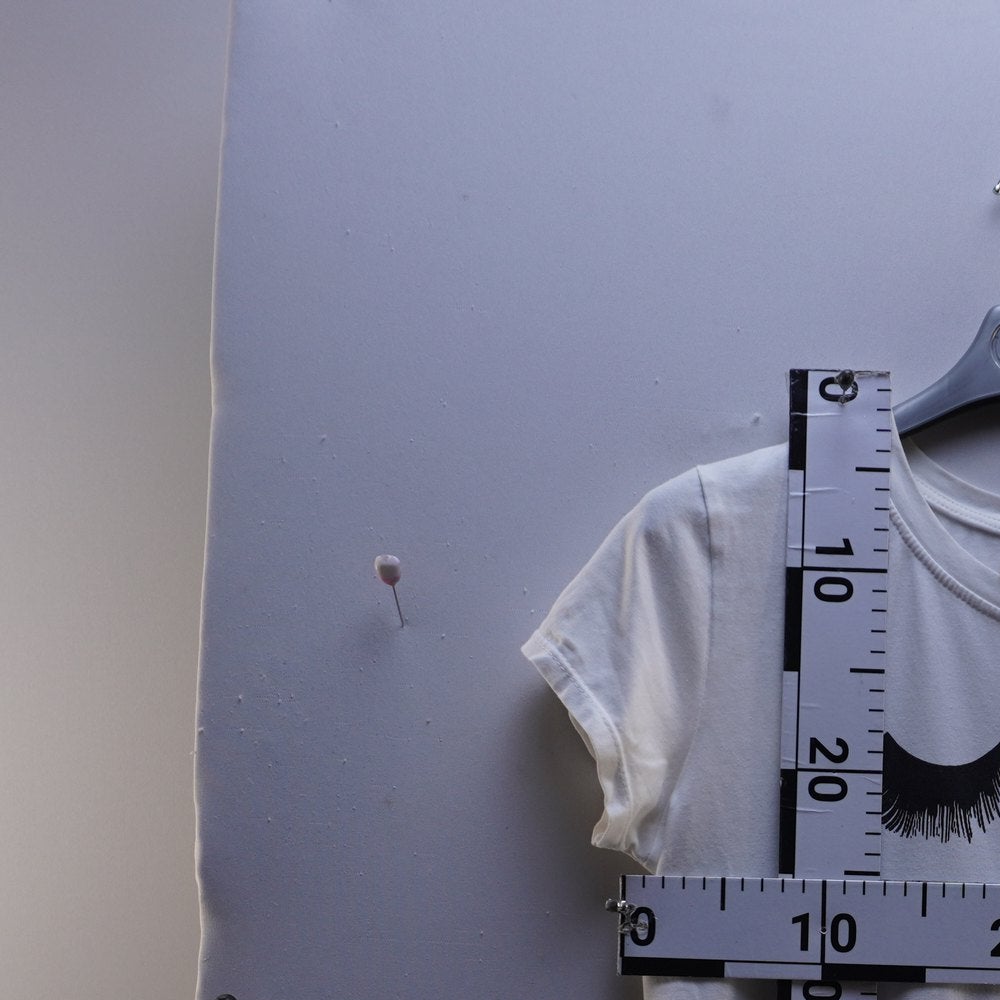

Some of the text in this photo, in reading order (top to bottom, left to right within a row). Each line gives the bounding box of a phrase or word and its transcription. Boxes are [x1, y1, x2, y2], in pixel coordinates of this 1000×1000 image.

[813, 537, 855, 603] 10
[807, 736, 850, 802] 20
[629, 906, 657, 947] 0
[791, 912, 857, 953] 10
